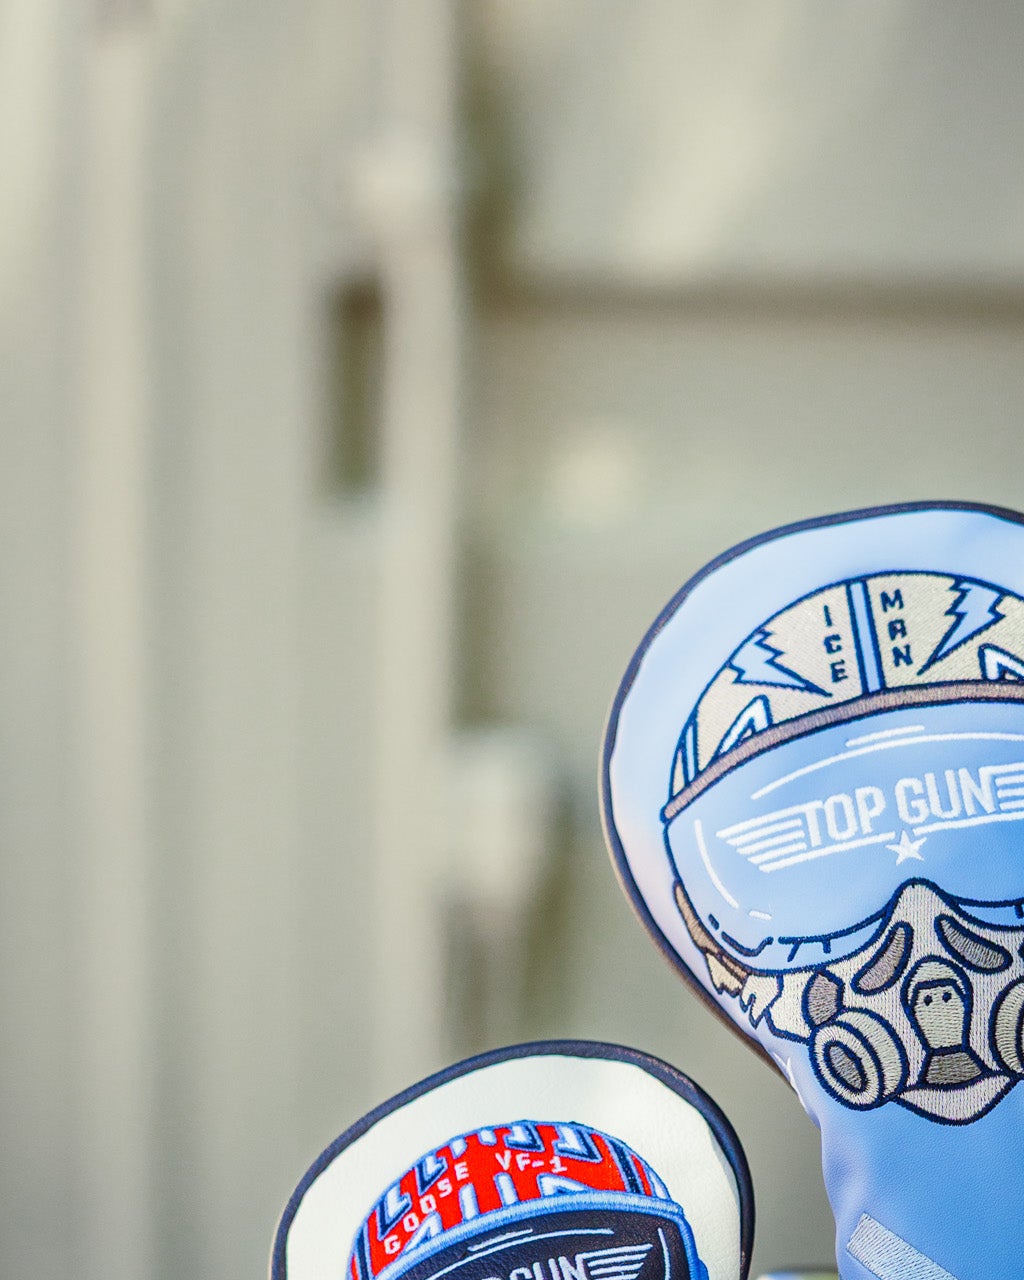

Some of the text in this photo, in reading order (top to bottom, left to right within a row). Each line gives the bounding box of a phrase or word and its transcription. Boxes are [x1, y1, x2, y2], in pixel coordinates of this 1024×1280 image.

[823, 604, 848, 683] ICE
[880, 588, 913, 667] MAN
[803, 768, 997, 847] TOP GUN
[384, 1150, 567, 1254] GOOSE VF-1
